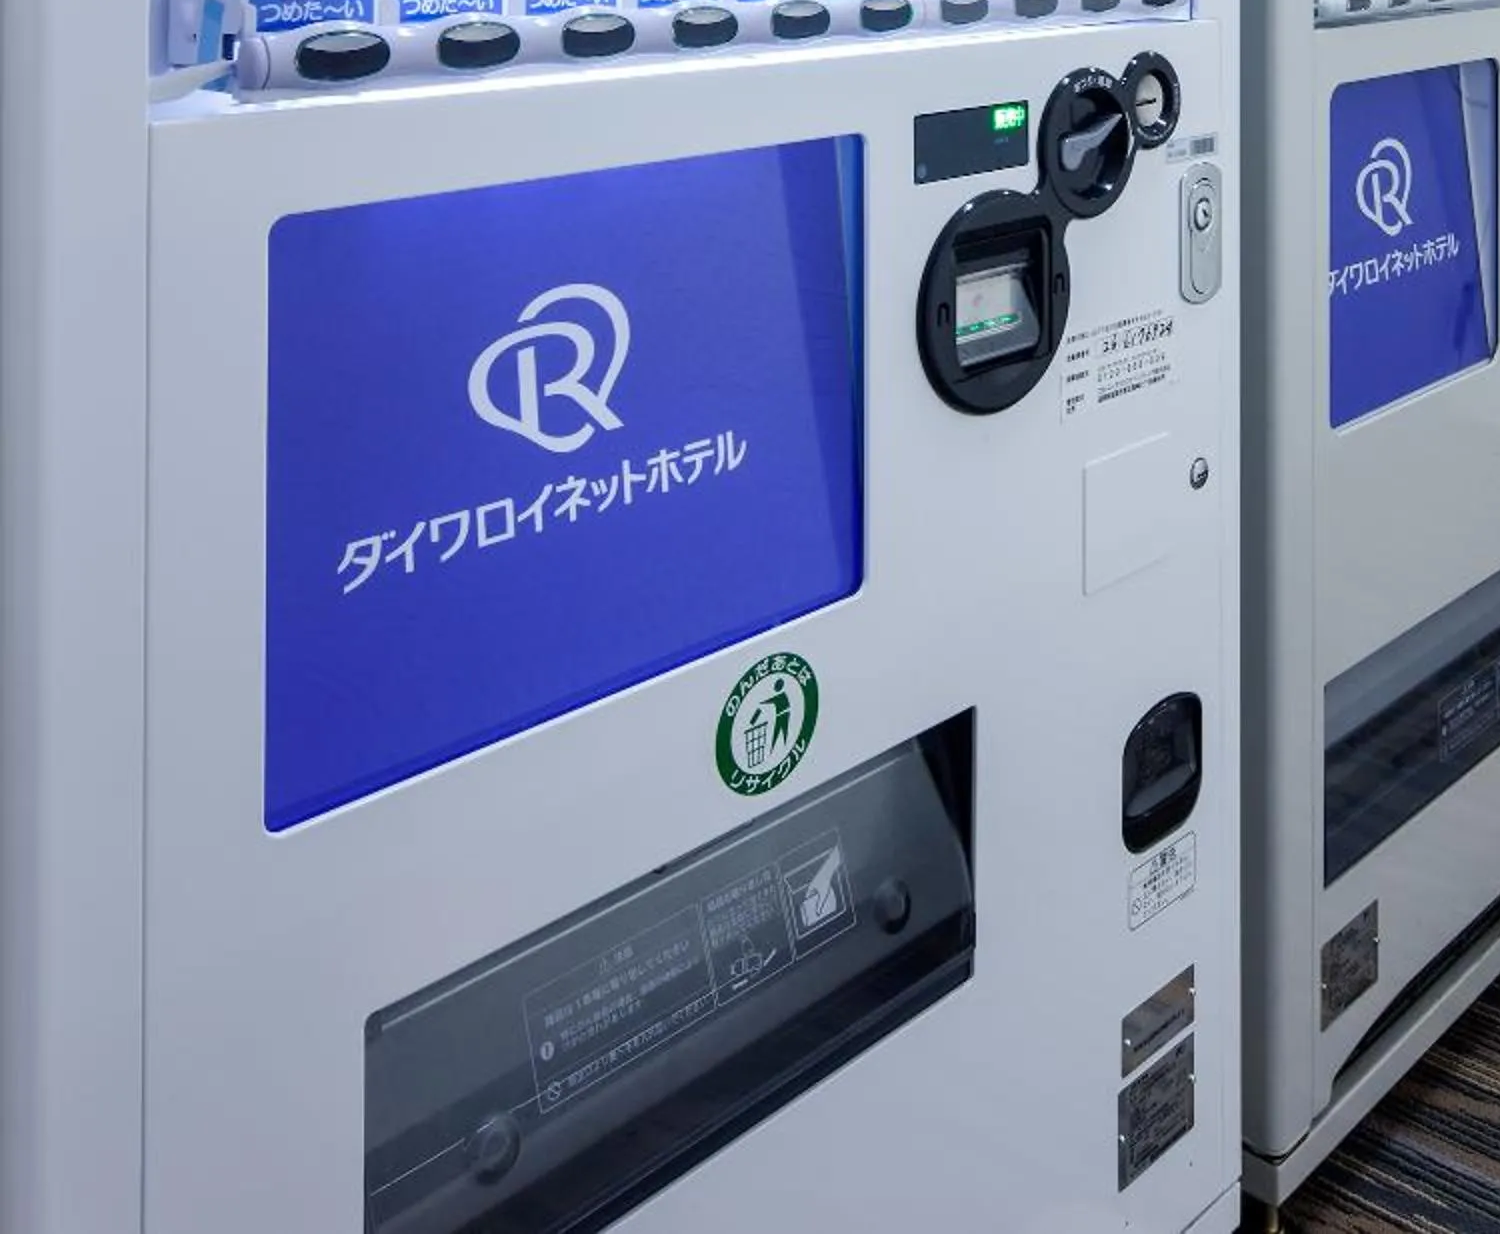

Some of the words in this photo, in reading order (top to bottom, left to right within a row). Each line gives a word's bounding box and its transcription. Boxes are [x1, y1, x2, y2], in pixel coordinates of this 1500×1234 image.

[337, 429, 748, 596] ダイワロイネットホテル
[730, 738, 806, 793] リサイクル
